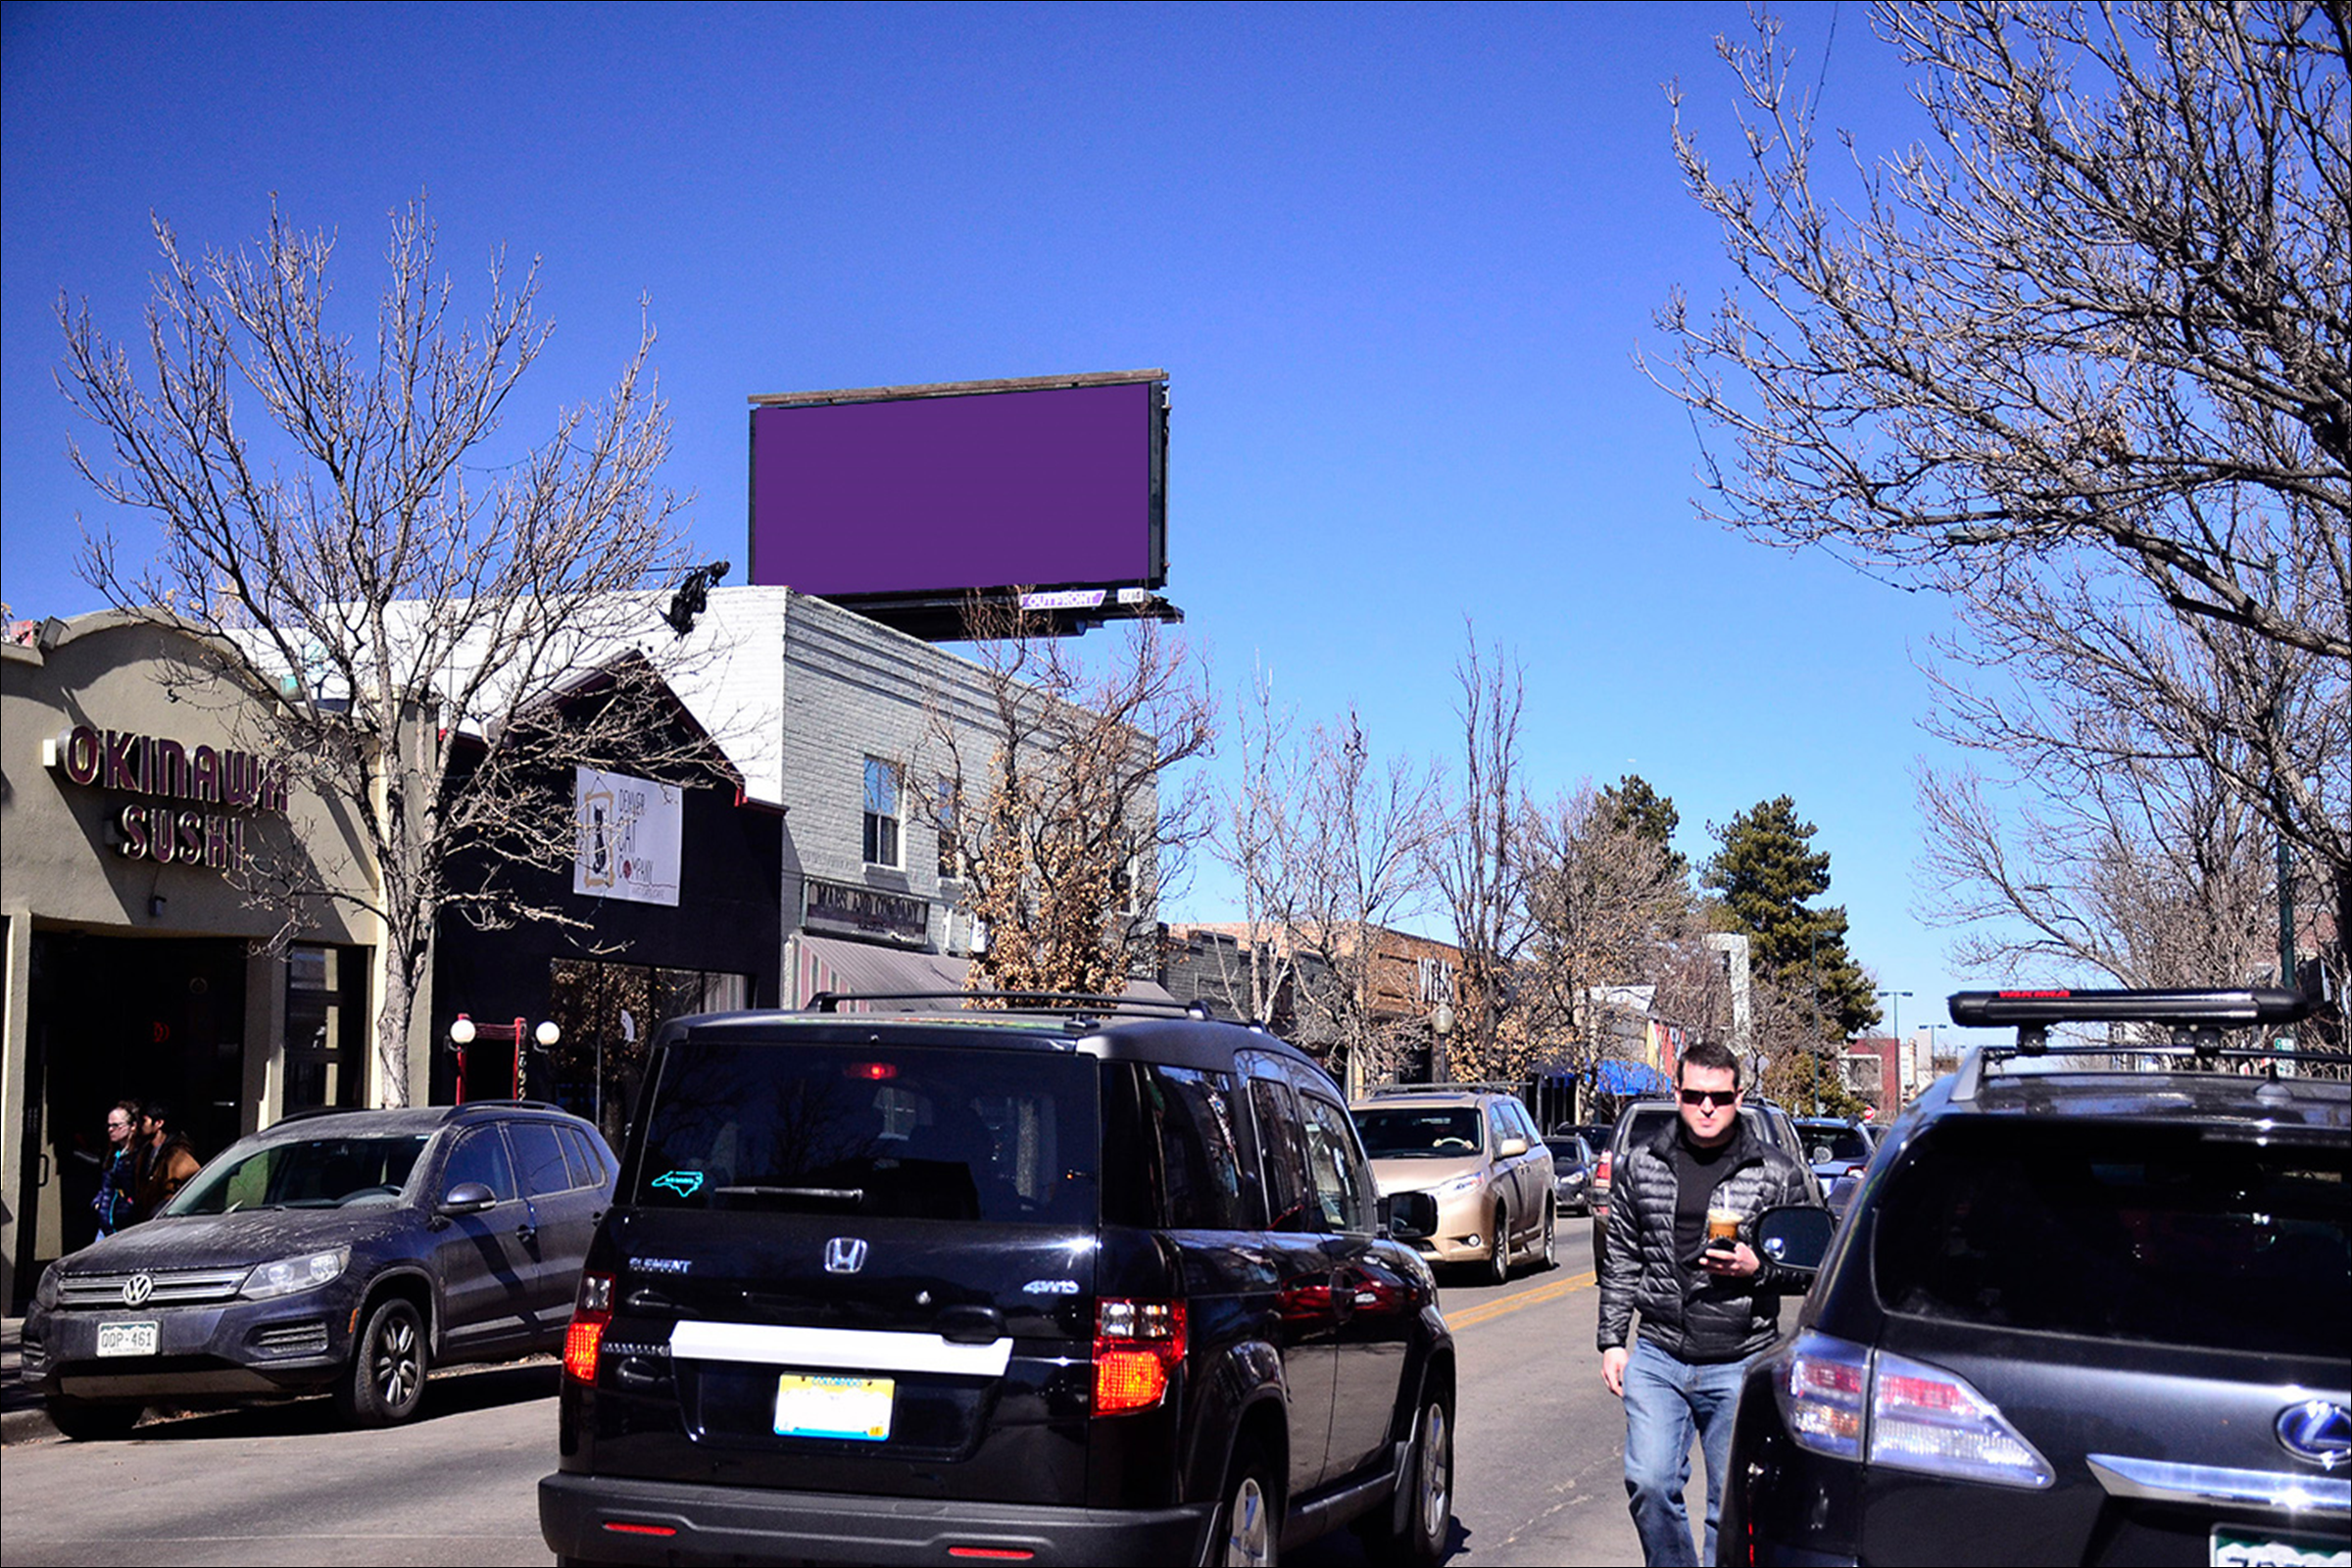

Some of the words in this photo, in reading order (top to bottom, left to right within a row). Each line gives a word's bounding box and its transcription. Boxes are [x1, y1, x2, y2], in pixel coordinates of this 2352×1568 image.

[1029, 592, 1096, 608] OUTFRONT
[65, 724, 288, 811] OKINAWA
[122, 805, 244, 871] SUSHI
[1999, 990, 2070, 999] YAKIMA
[628, 1257, 692, 1273] ELEMENT
